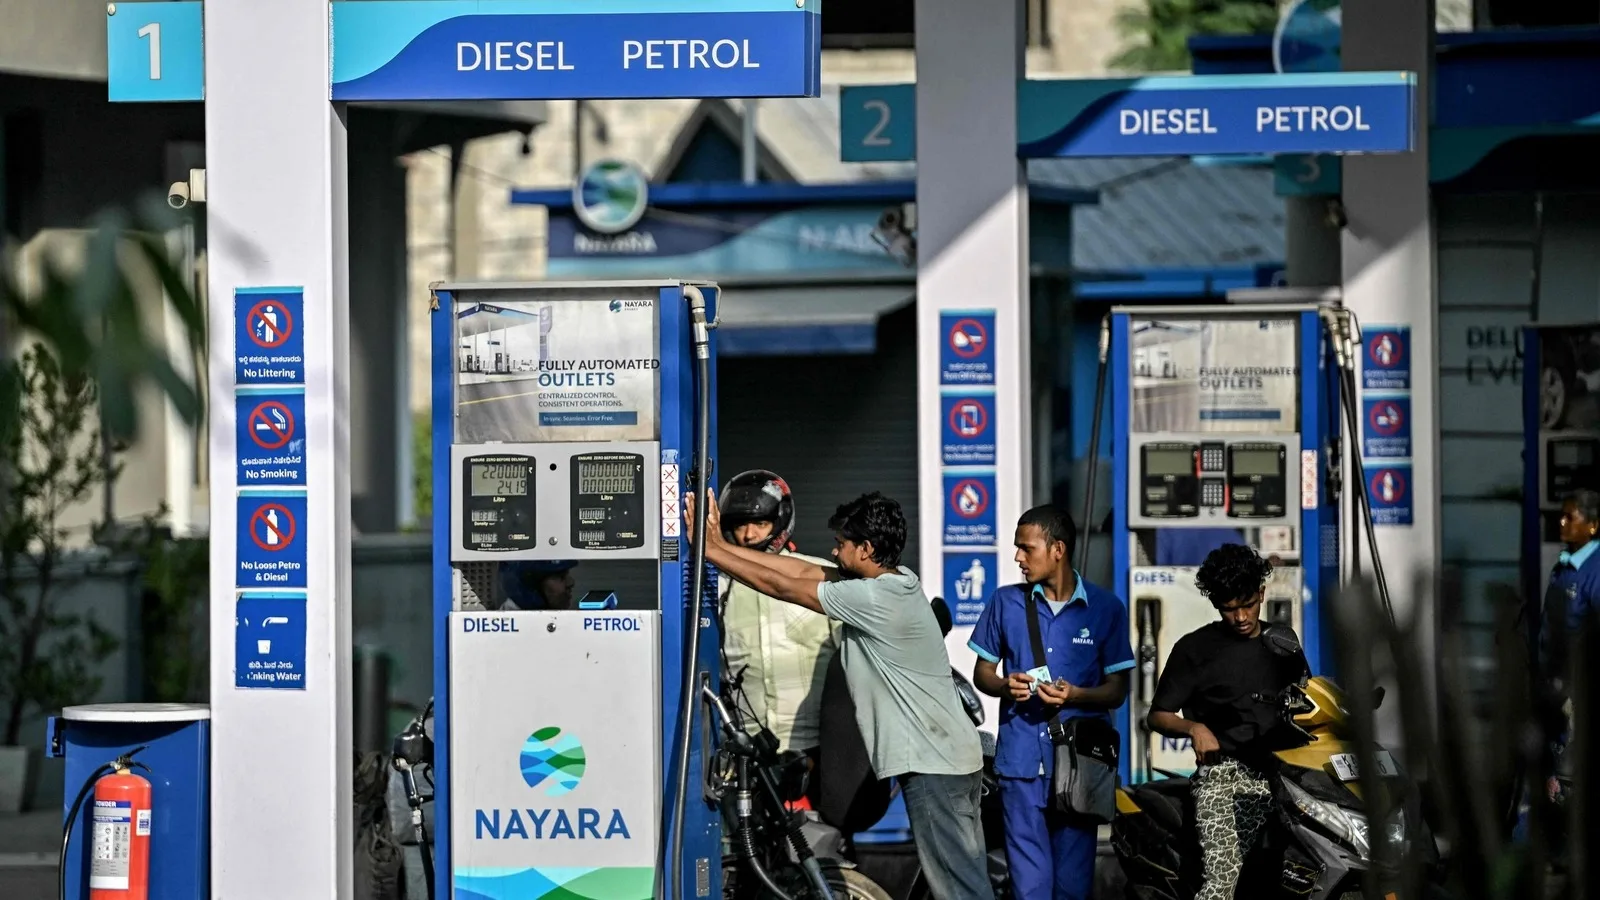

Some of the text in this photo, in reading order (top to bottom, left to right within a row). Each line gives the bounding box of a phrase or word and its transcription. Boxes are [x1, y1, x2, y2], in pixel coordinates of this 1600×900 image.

[138, 22, 161, 80] 1
[456, 38, 760, 71] DIESEL PETROL
[863, 100, 892, 146] 2
[1119, 105, 1371, 135] DIESEL PETROL
[538, 358, 661, 371] FULLY AUTOMATED
[1199, 366, 1229, 376] FULLY
[244, 368, 296, 379] No Littering
[538, 372, 615, 387] OUTLETS
[1200, 377, 1264, 390] OUTLETS
[538, 392, 583, 400] CENTRALIZED
[538, 399, 624, 408] CONSISTENT OPERATIONS.
[246, 468, 298, 479] No Smoking
[241, 560, 301, 570] No Loose Petro
[255, 572, 288, 581] & Diesel
[463, 617, 641, 633] DIESEL PETROL
[276, 671, 302, 680] Water
[475, 807, 631, 840] NAYARA
